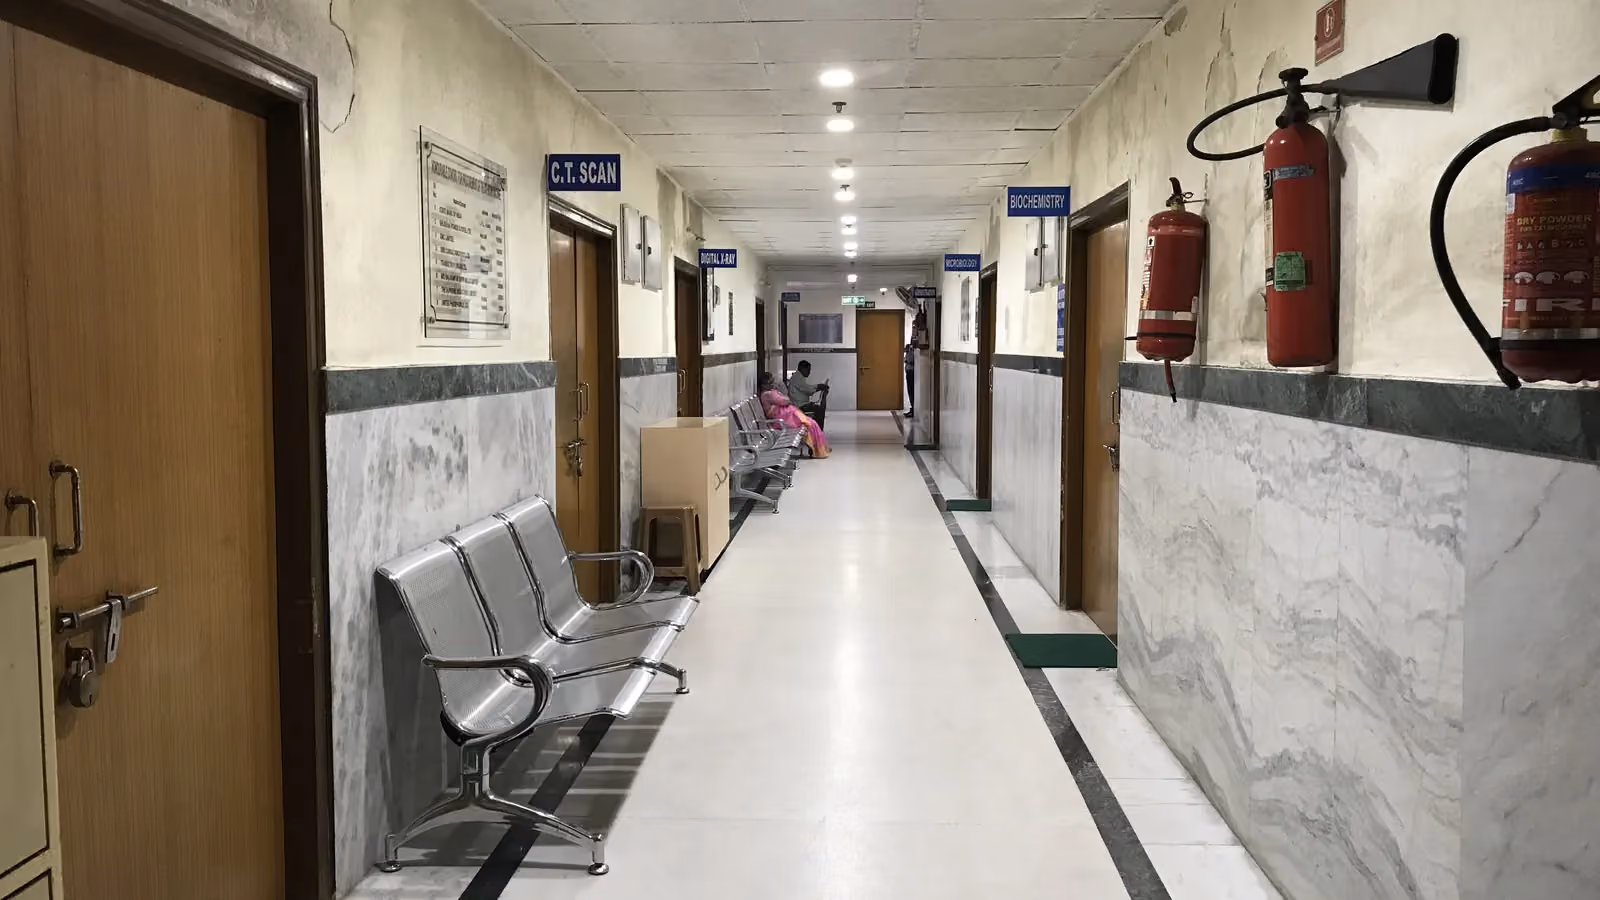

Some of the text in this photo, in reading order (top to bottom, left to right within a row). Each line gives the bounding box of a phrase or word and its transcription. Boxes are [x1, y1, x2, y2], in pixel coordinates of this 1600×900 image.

[551, 161, 617, 184] C.T. SCAN
[1010, 194, 1065, 209] BIOCHEMISTRY
[1517, 214, 1593, 226] DRY POWDER
[720, 253, 736, 264] X-RAY
